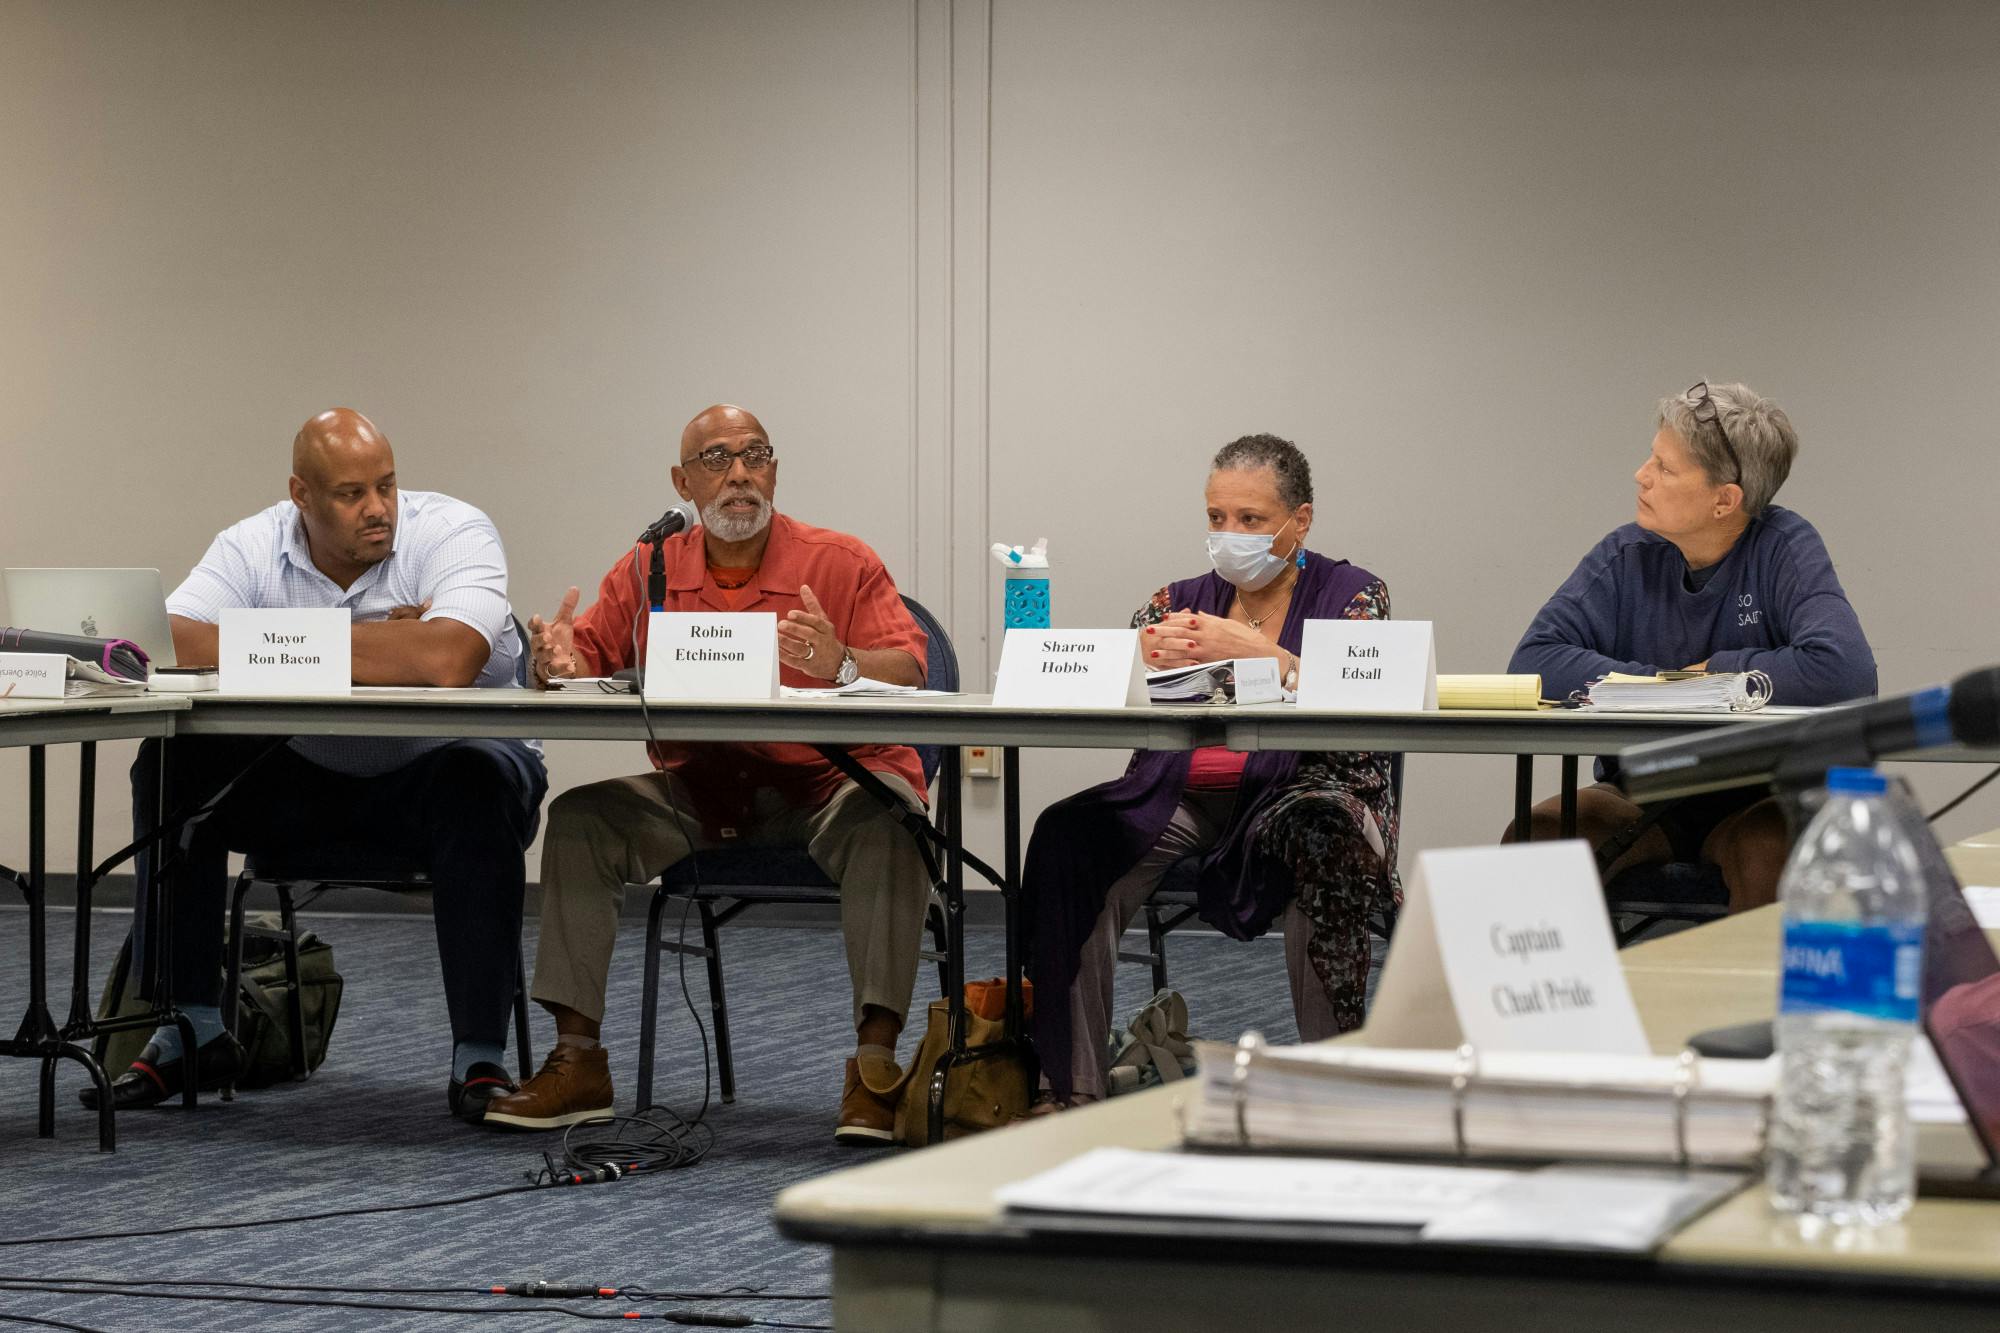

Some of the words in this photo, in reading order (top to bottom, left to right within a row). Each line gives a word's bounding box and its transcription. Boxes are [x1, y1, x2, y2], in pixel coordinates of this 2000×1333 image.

[1738, 593, 1752, 607] SO
[690, 625, 732, 638] Robin
[262, 632, 307, 647] Mayor
[1041, 640, 1095, 652] Sharon
[675, 648, 745, 661] Etchinson
[1347, 645, 1379, 658] Kath
[248, 653, 275, 665] Ron
[280, 653, 321, 665] Bacon
[25, 669, 47, 678] Police
[1041, 661, 1089, 673] Hobbs
[1342, 667, 1382, 680] Edsall
[1489, 920, 1564, 966] Captain
[1490, 979, 1543, 1018] Chad
[1542, 976, 1598, 1012] Pride
